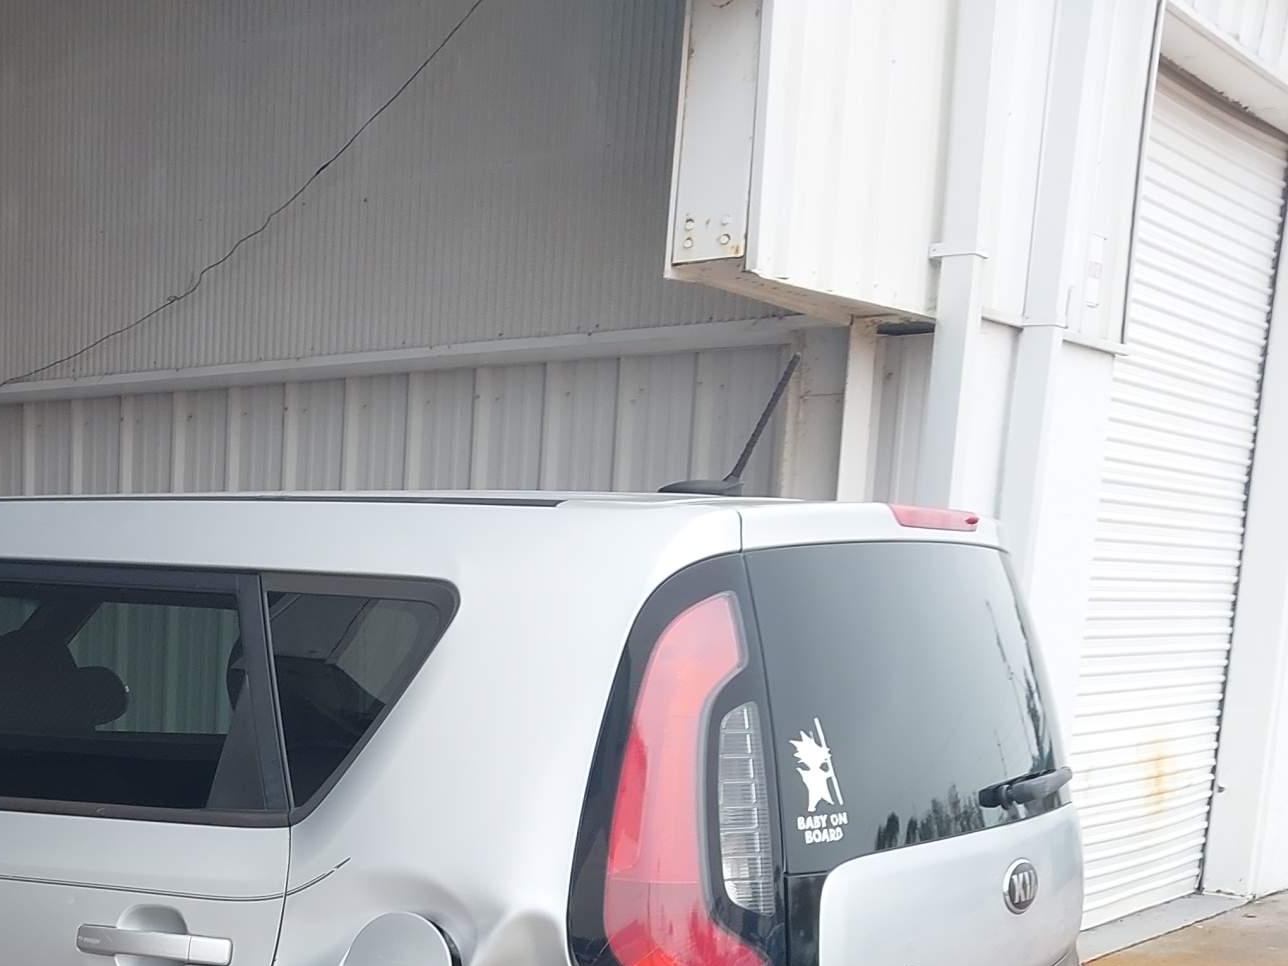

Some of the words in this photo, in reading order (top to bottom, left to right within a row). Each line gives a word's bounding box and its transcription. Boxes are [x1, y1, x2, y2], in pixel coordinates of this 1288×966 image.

[797, 814, 828, 830] BABY
[830, 812, 848, 827] ON
[804, 827, 844, 844] BOARD
